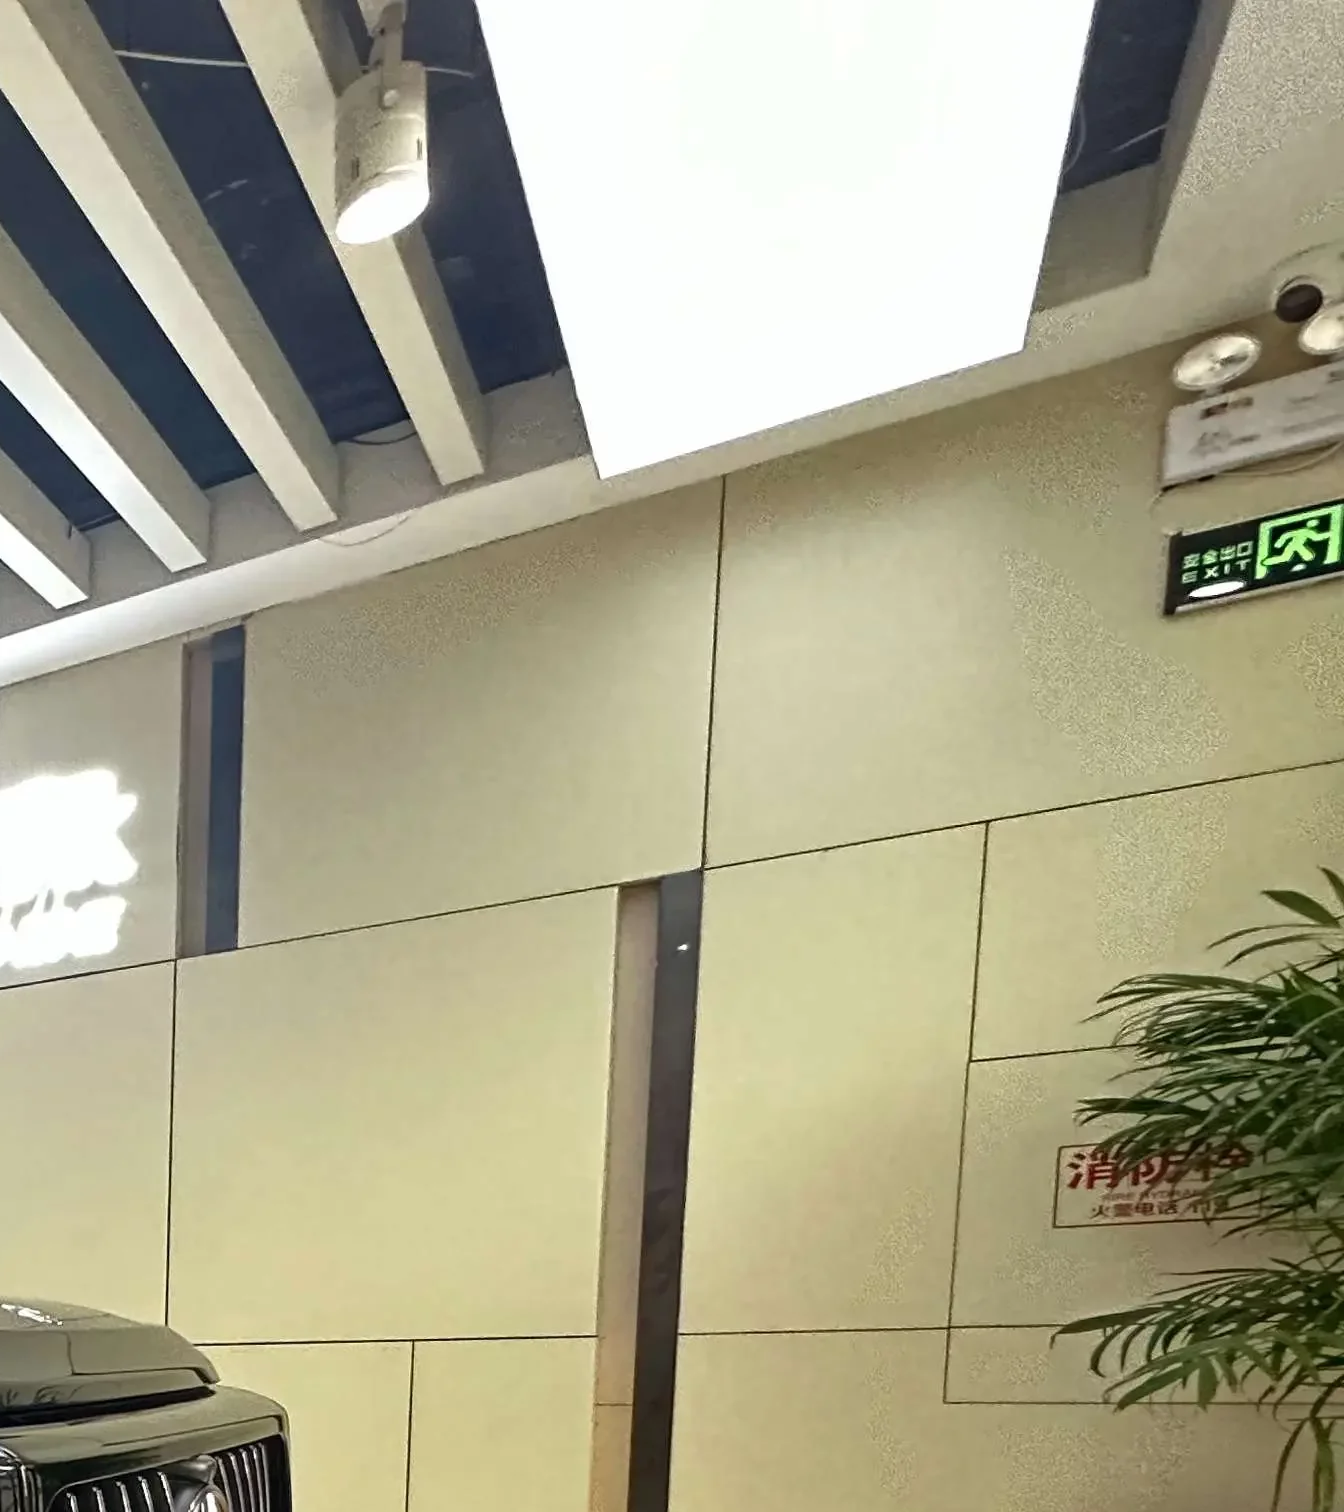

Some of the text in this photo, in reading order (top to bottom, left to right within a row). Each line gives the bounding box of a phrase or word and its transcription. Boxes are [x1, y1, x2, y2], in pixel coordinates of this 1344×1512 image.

[1181, 541, 1253, 570] 安全出口
[1181, 559, 1251, 584] EXIT
